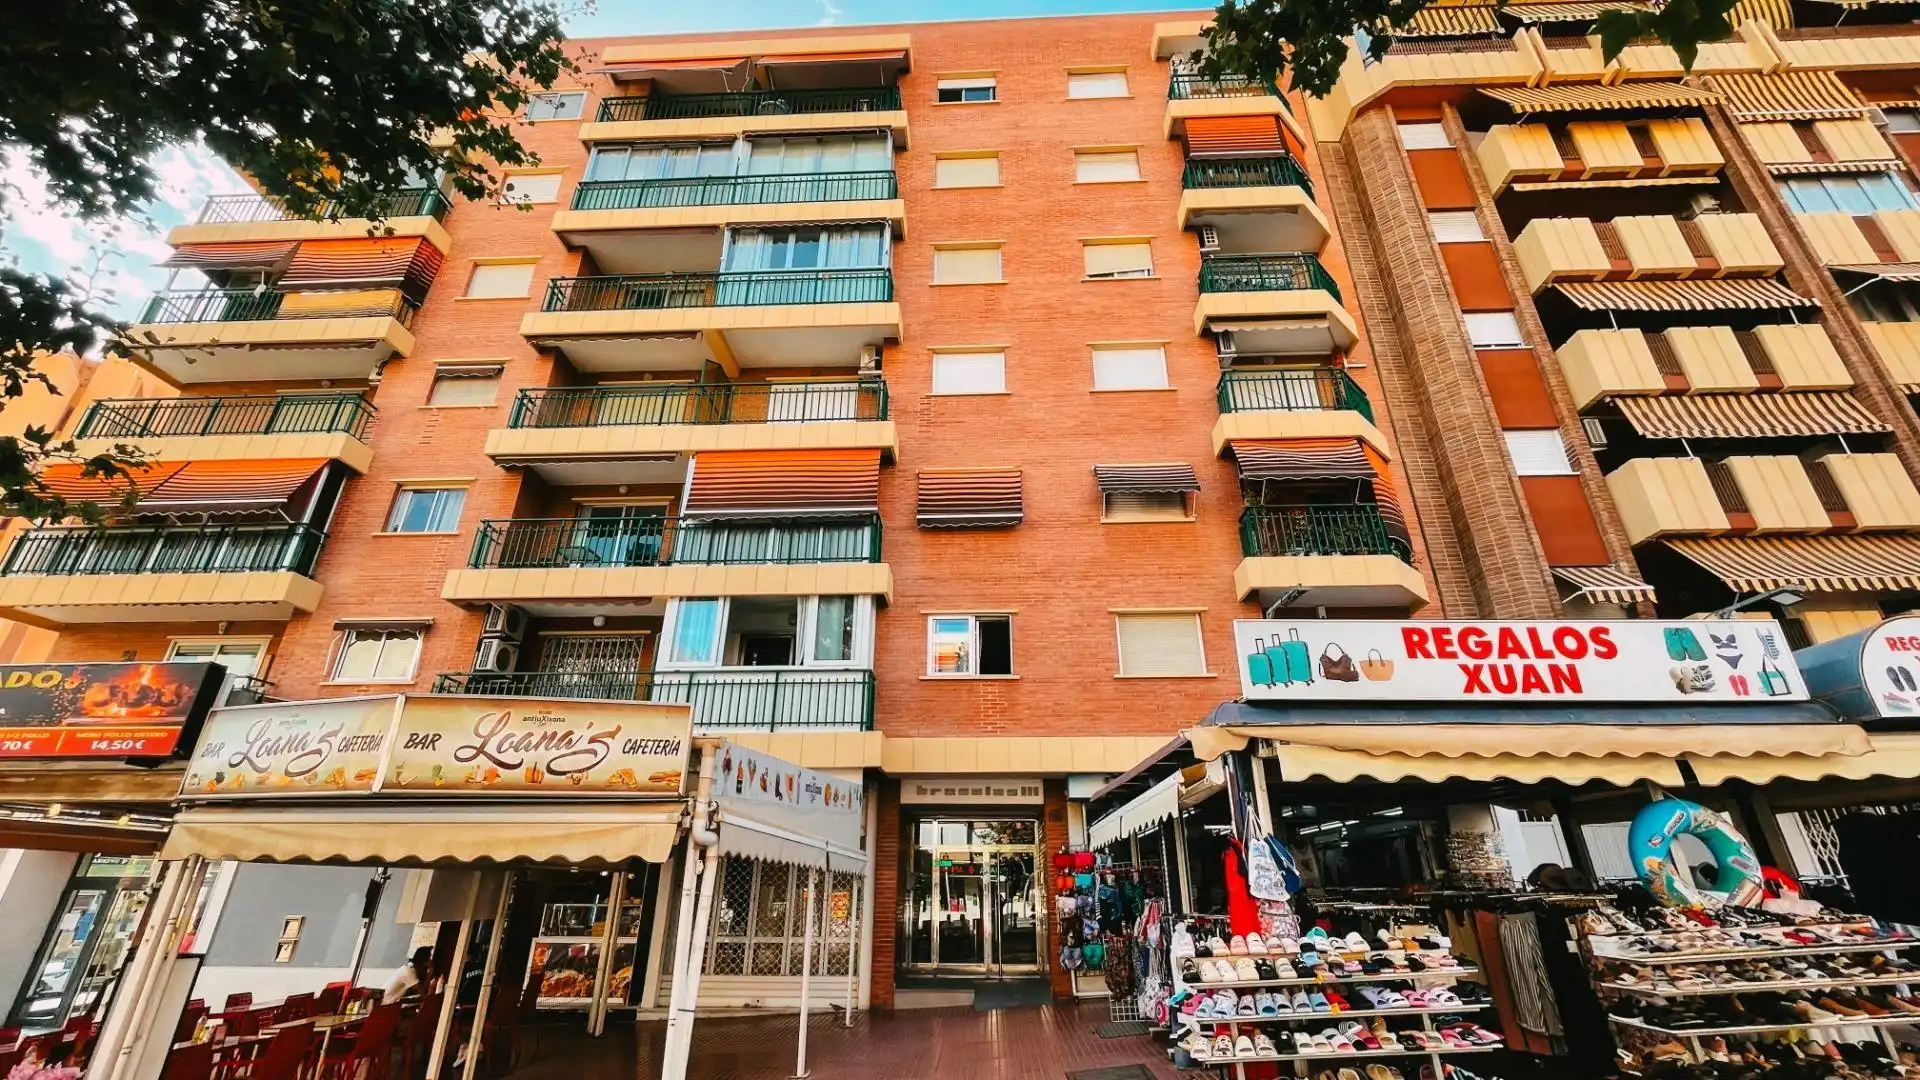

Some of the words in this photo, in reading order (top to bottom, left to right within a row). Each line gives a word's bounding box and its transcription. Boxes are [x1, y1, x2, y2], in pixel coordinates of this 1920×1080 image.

[1401, 626, 1618, 660] REGALOS
[0, 670, 62, 689] DO
[1458, 663, 1583, 694] XUAN
[201, 742, 226, 759] BAR
[228, 717, 344, 778] Loana's
[404, 732, 442, 751] BAR
[454, 710, 622, 776] Loana's
